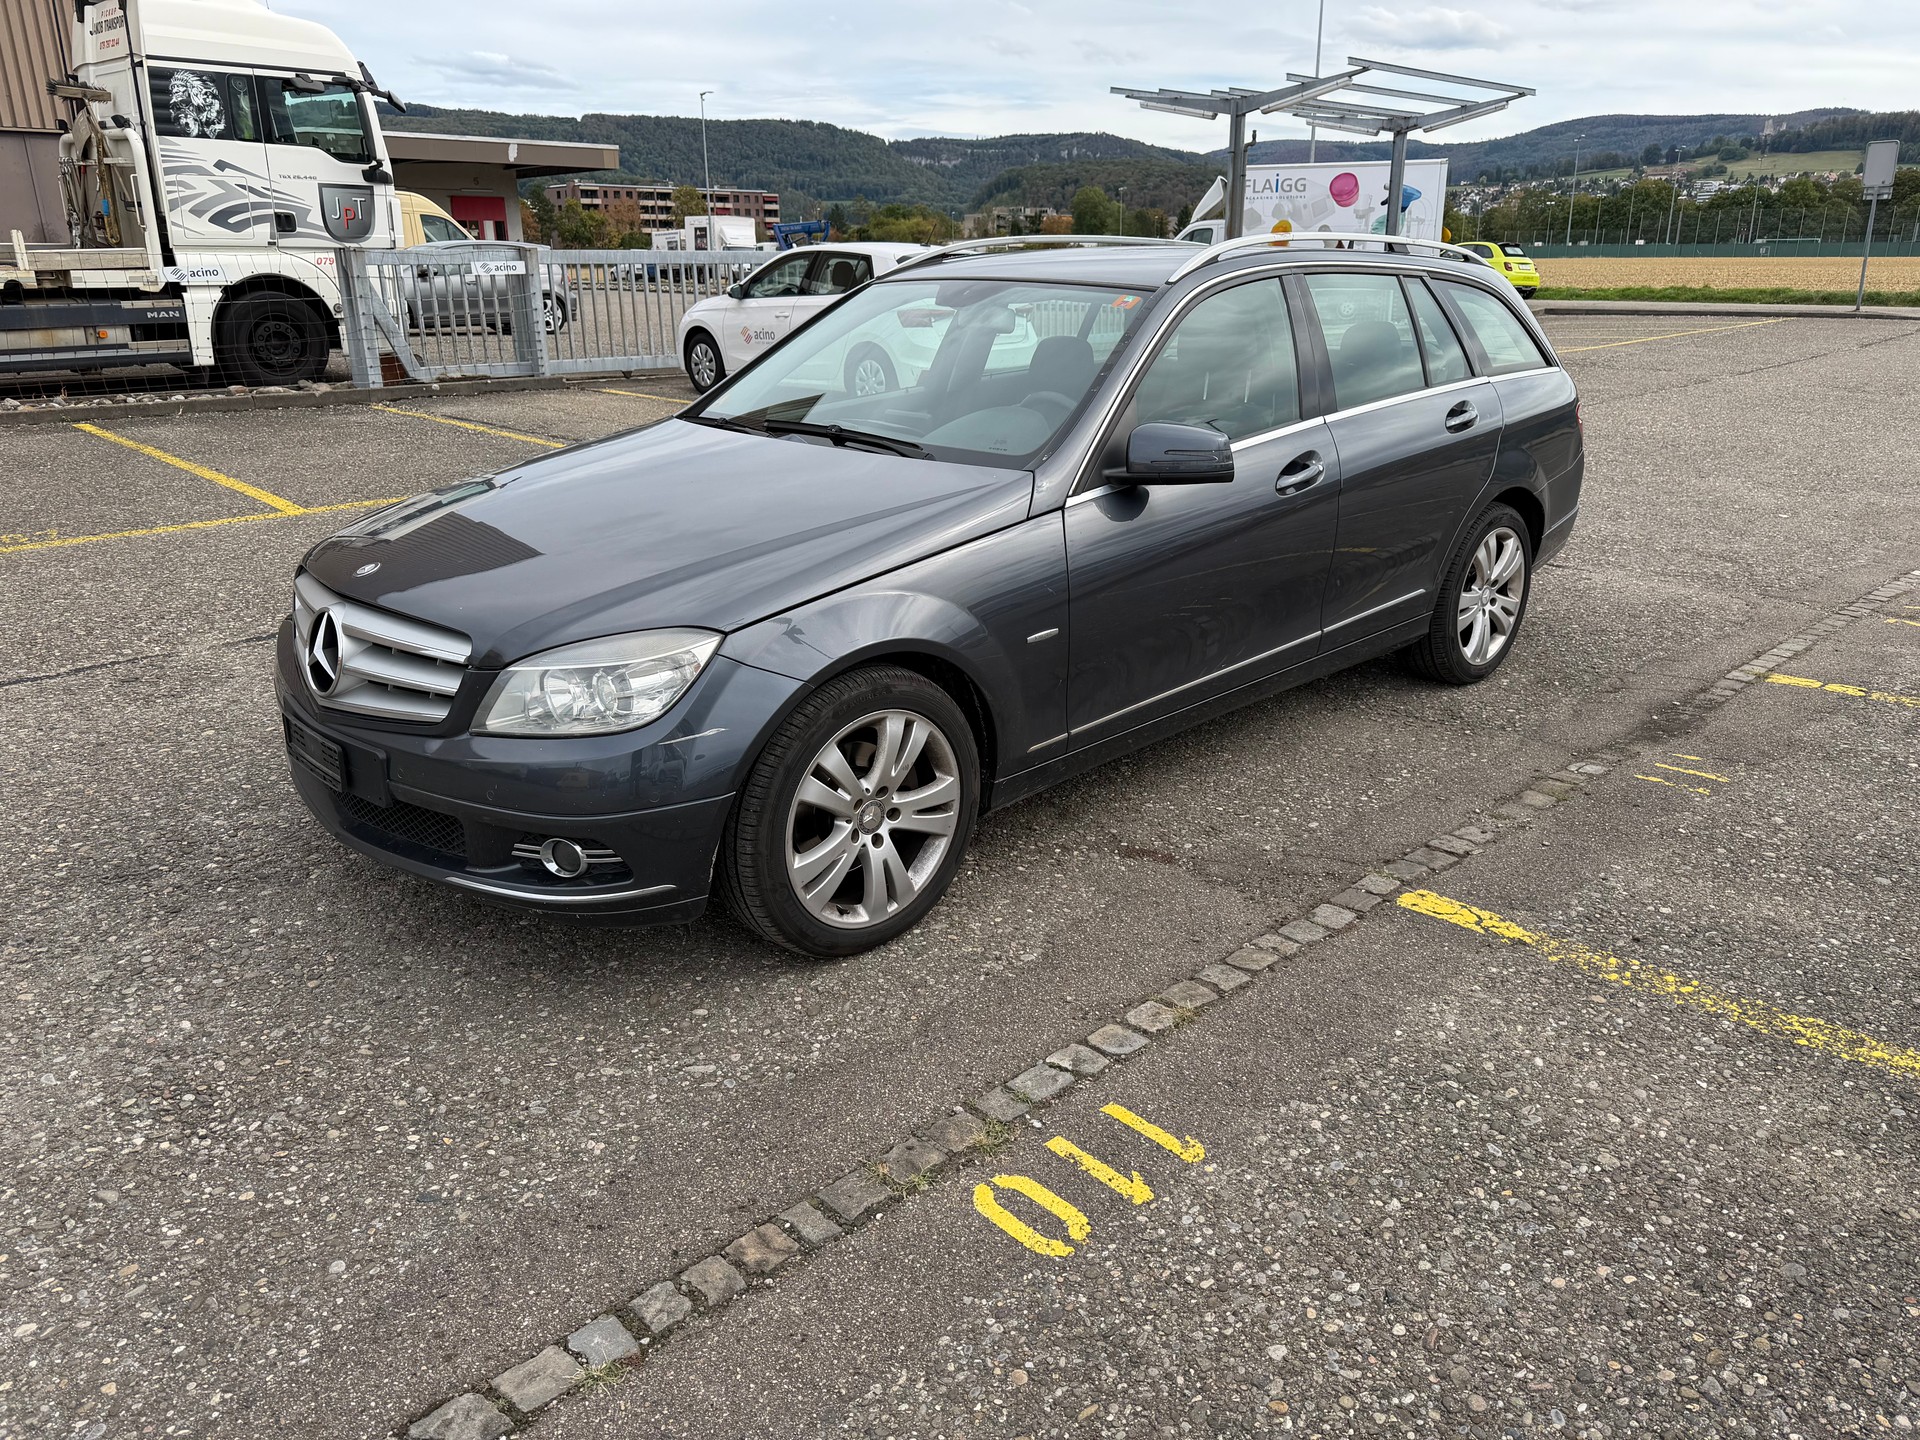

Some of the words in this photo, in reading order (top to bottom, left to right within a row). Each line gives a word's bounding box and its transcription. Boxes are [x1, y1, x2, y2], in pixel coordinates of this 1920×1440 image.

[104, 15, 124, 32] TRANSPOR
[331, 197, 367, 230] JPT
[316, 257, 335, 265] 079
[189, 267, 219, 278] acino
[494, 262, 517, 272] acino
[147, 310, 180, 319] MAN
[753, 327, 776, 341] acino
